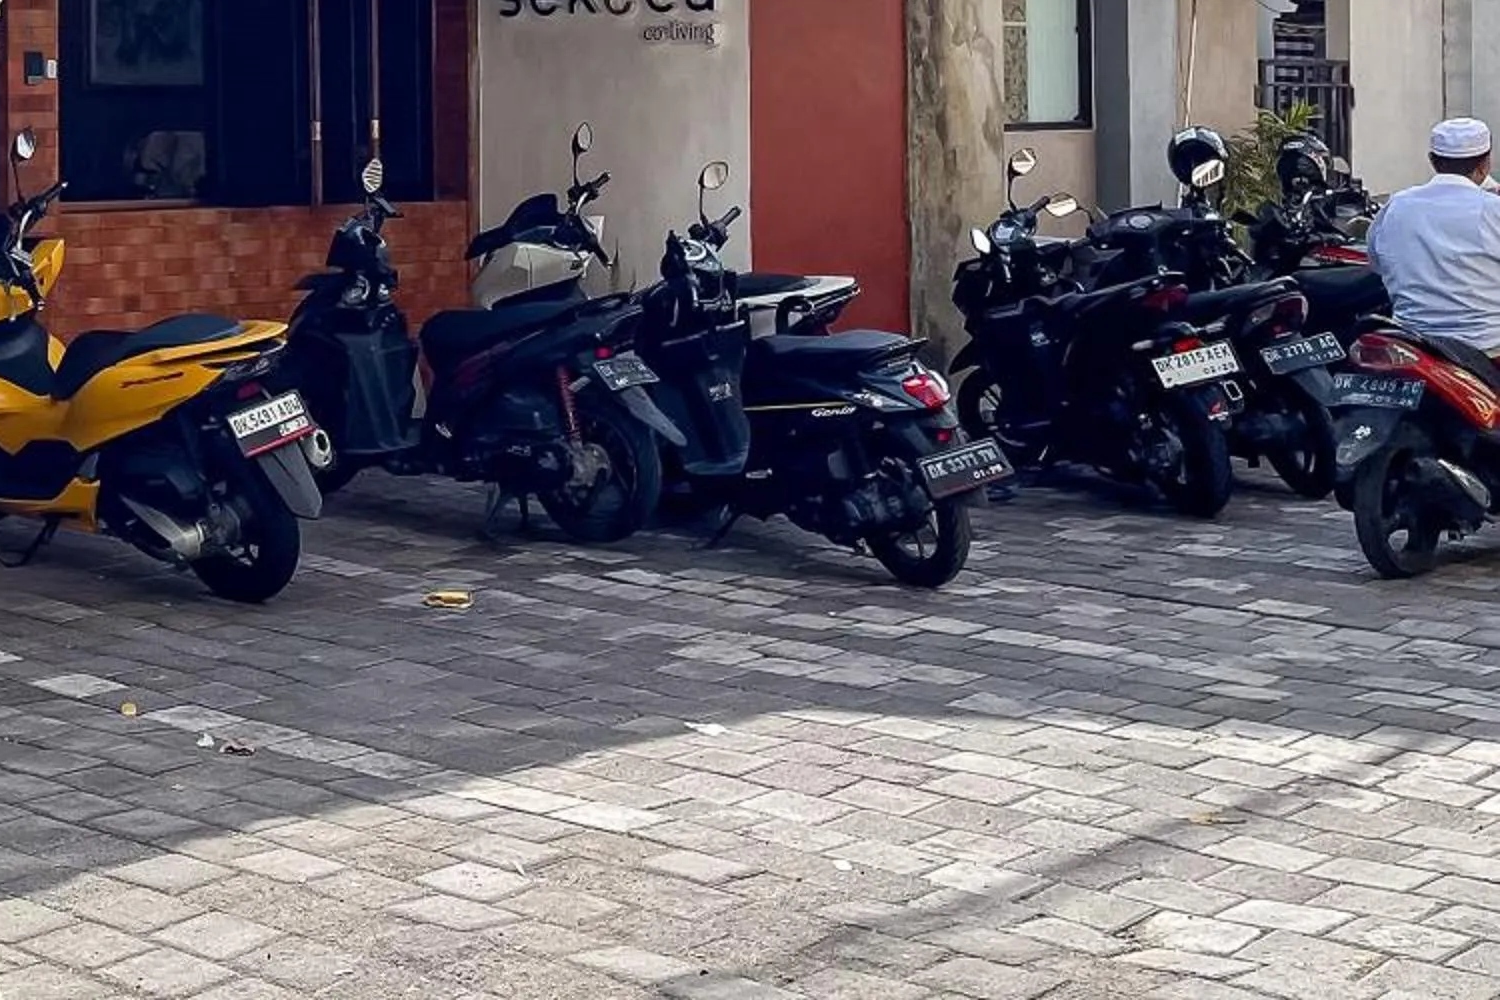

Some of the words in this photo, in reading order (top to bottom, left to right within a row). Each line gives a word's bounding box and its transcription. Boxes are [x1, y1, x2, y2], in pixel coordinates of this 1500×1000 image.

[1156, 357, 1174, 373] DK
[233, 417, 253, 434] DK
[927, 461, 948, 479] DK
